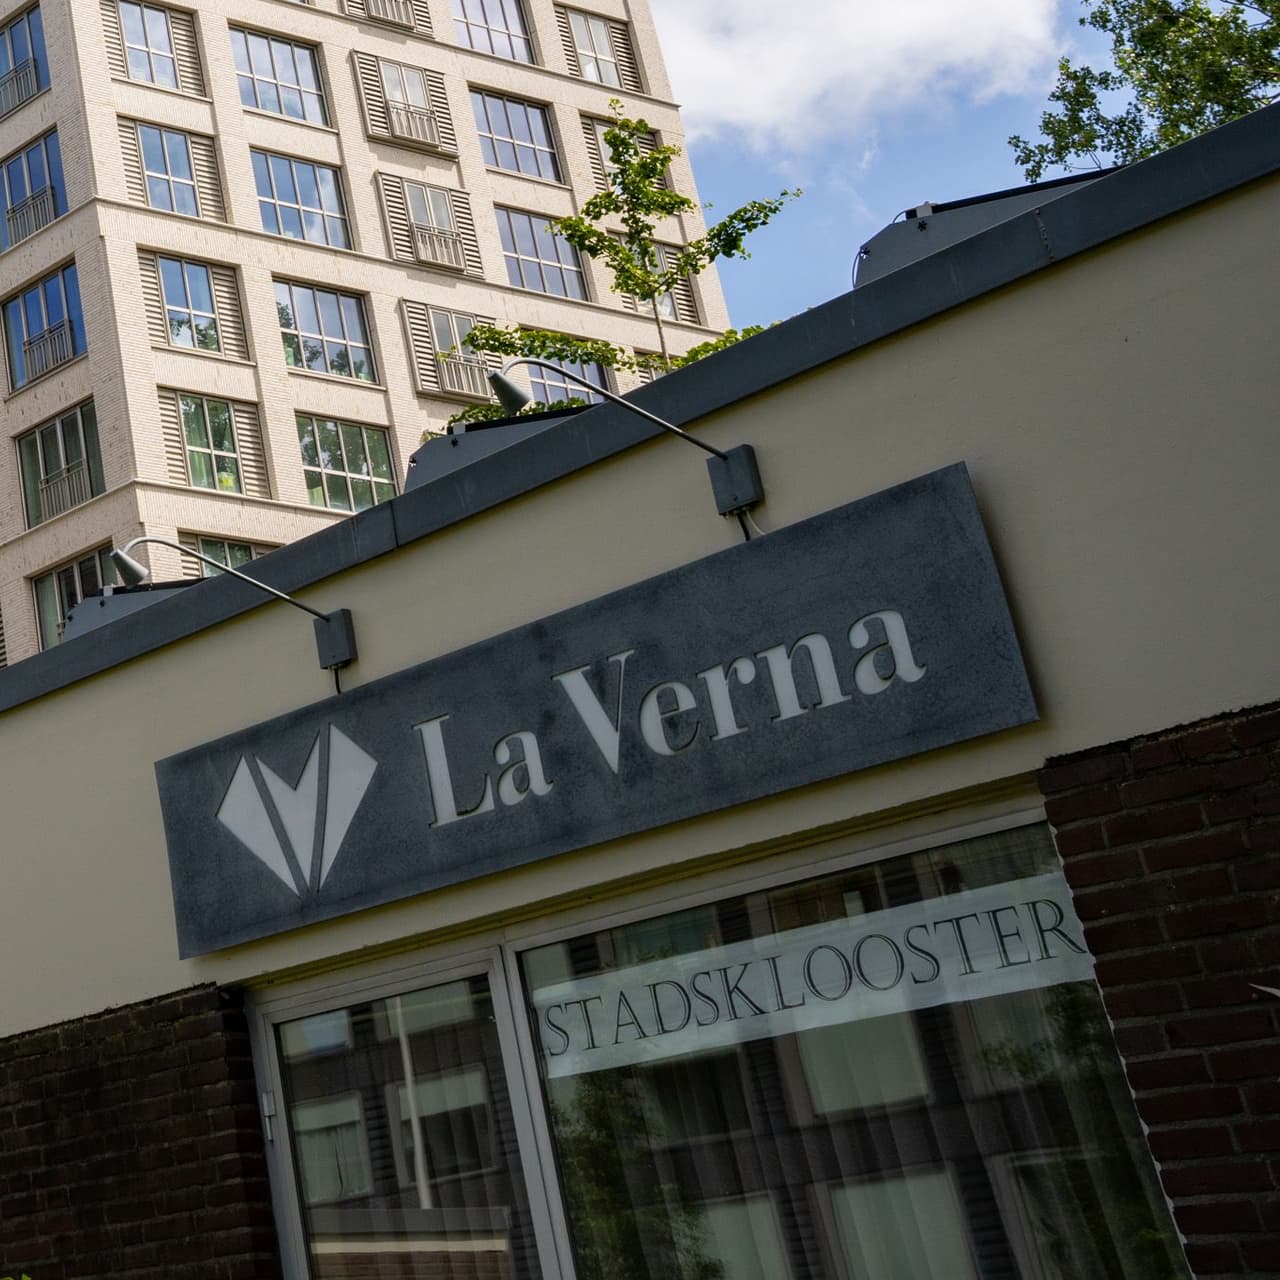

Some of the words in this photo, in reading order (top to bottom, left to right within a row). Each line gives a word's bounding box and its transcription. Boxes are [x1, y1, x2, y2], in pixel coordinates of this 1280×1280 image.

[411, 714, 555, 829] La
[552, 607, 928, 775] Verna
[543, 898, 1088, 1057] STADSKLOOSTER
